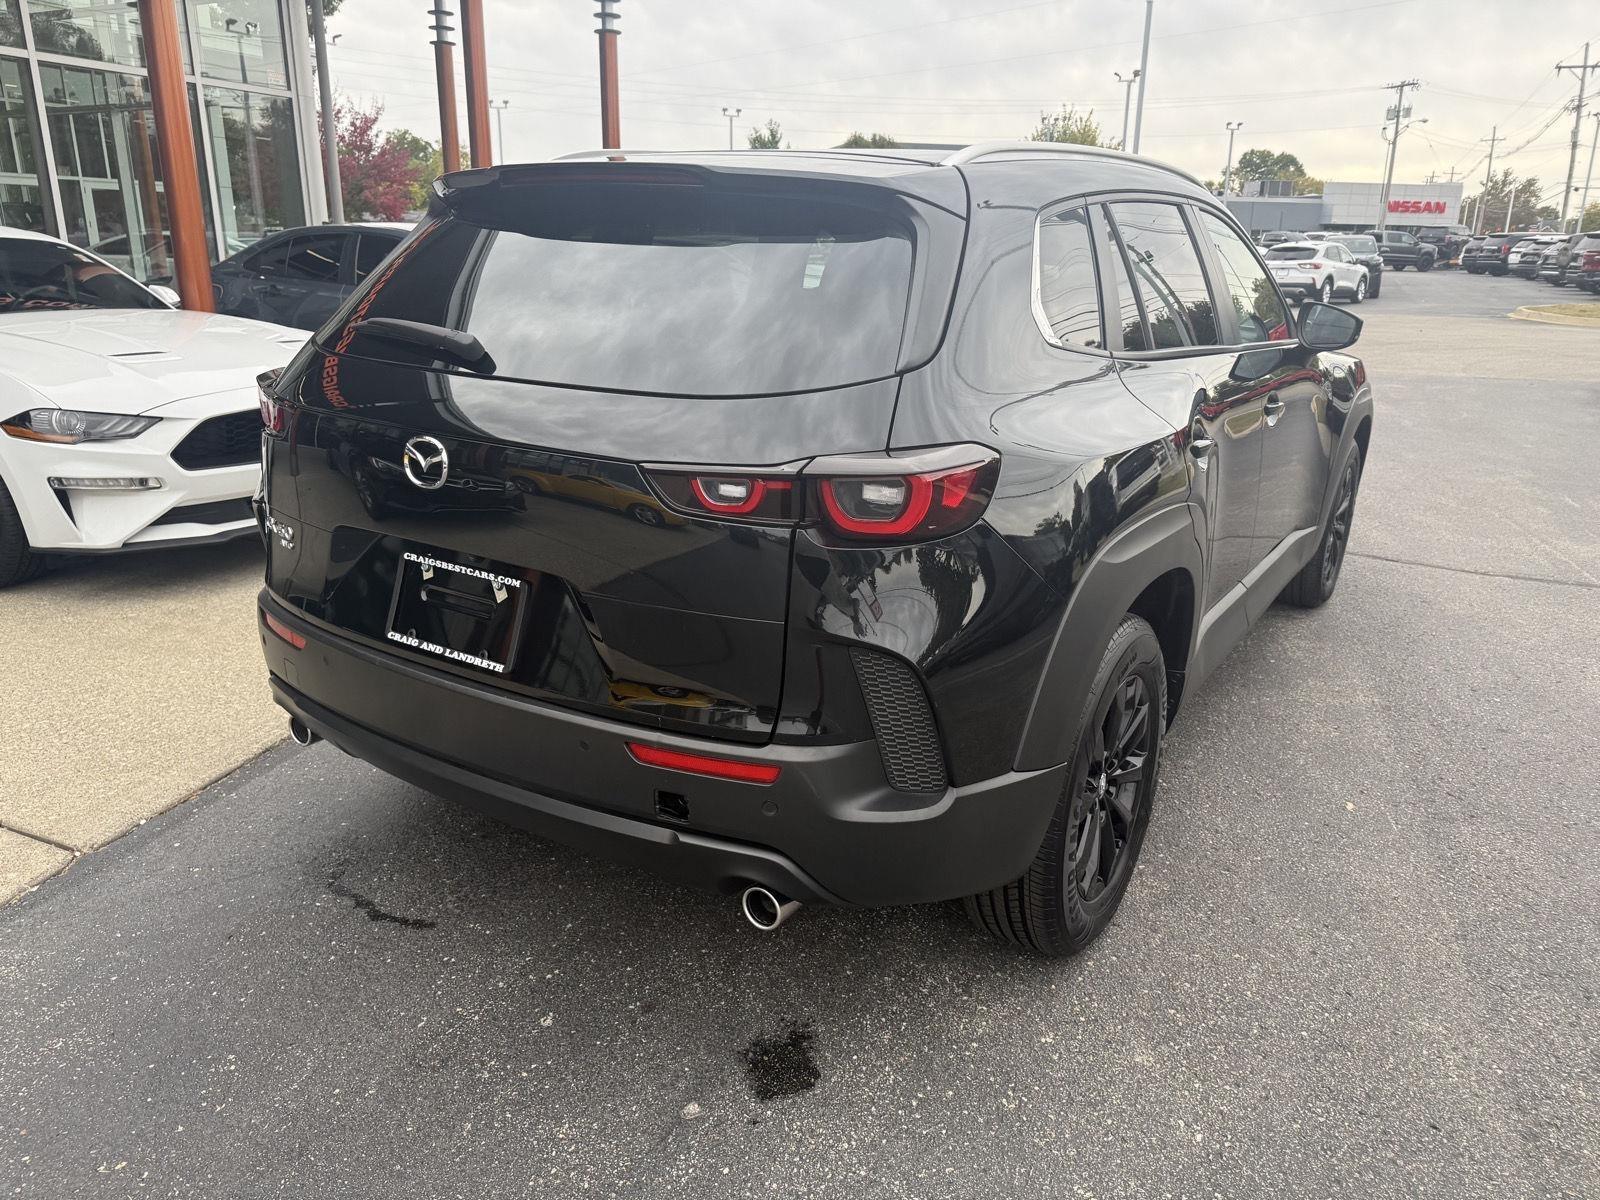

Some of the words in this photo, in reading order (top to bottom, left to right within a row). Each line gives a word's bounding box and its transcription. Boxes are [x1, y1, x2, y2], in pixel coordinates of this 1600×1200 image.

[1388, 199, 1446, 213] NISSAN
[403, 552, 521, 588] CRAIGSBESTCARS.COM
[387, 631, 419, 647] CRAIG
[420, 641, 443, 654] AND
[444, 649, 505, 673] LANDRETH
